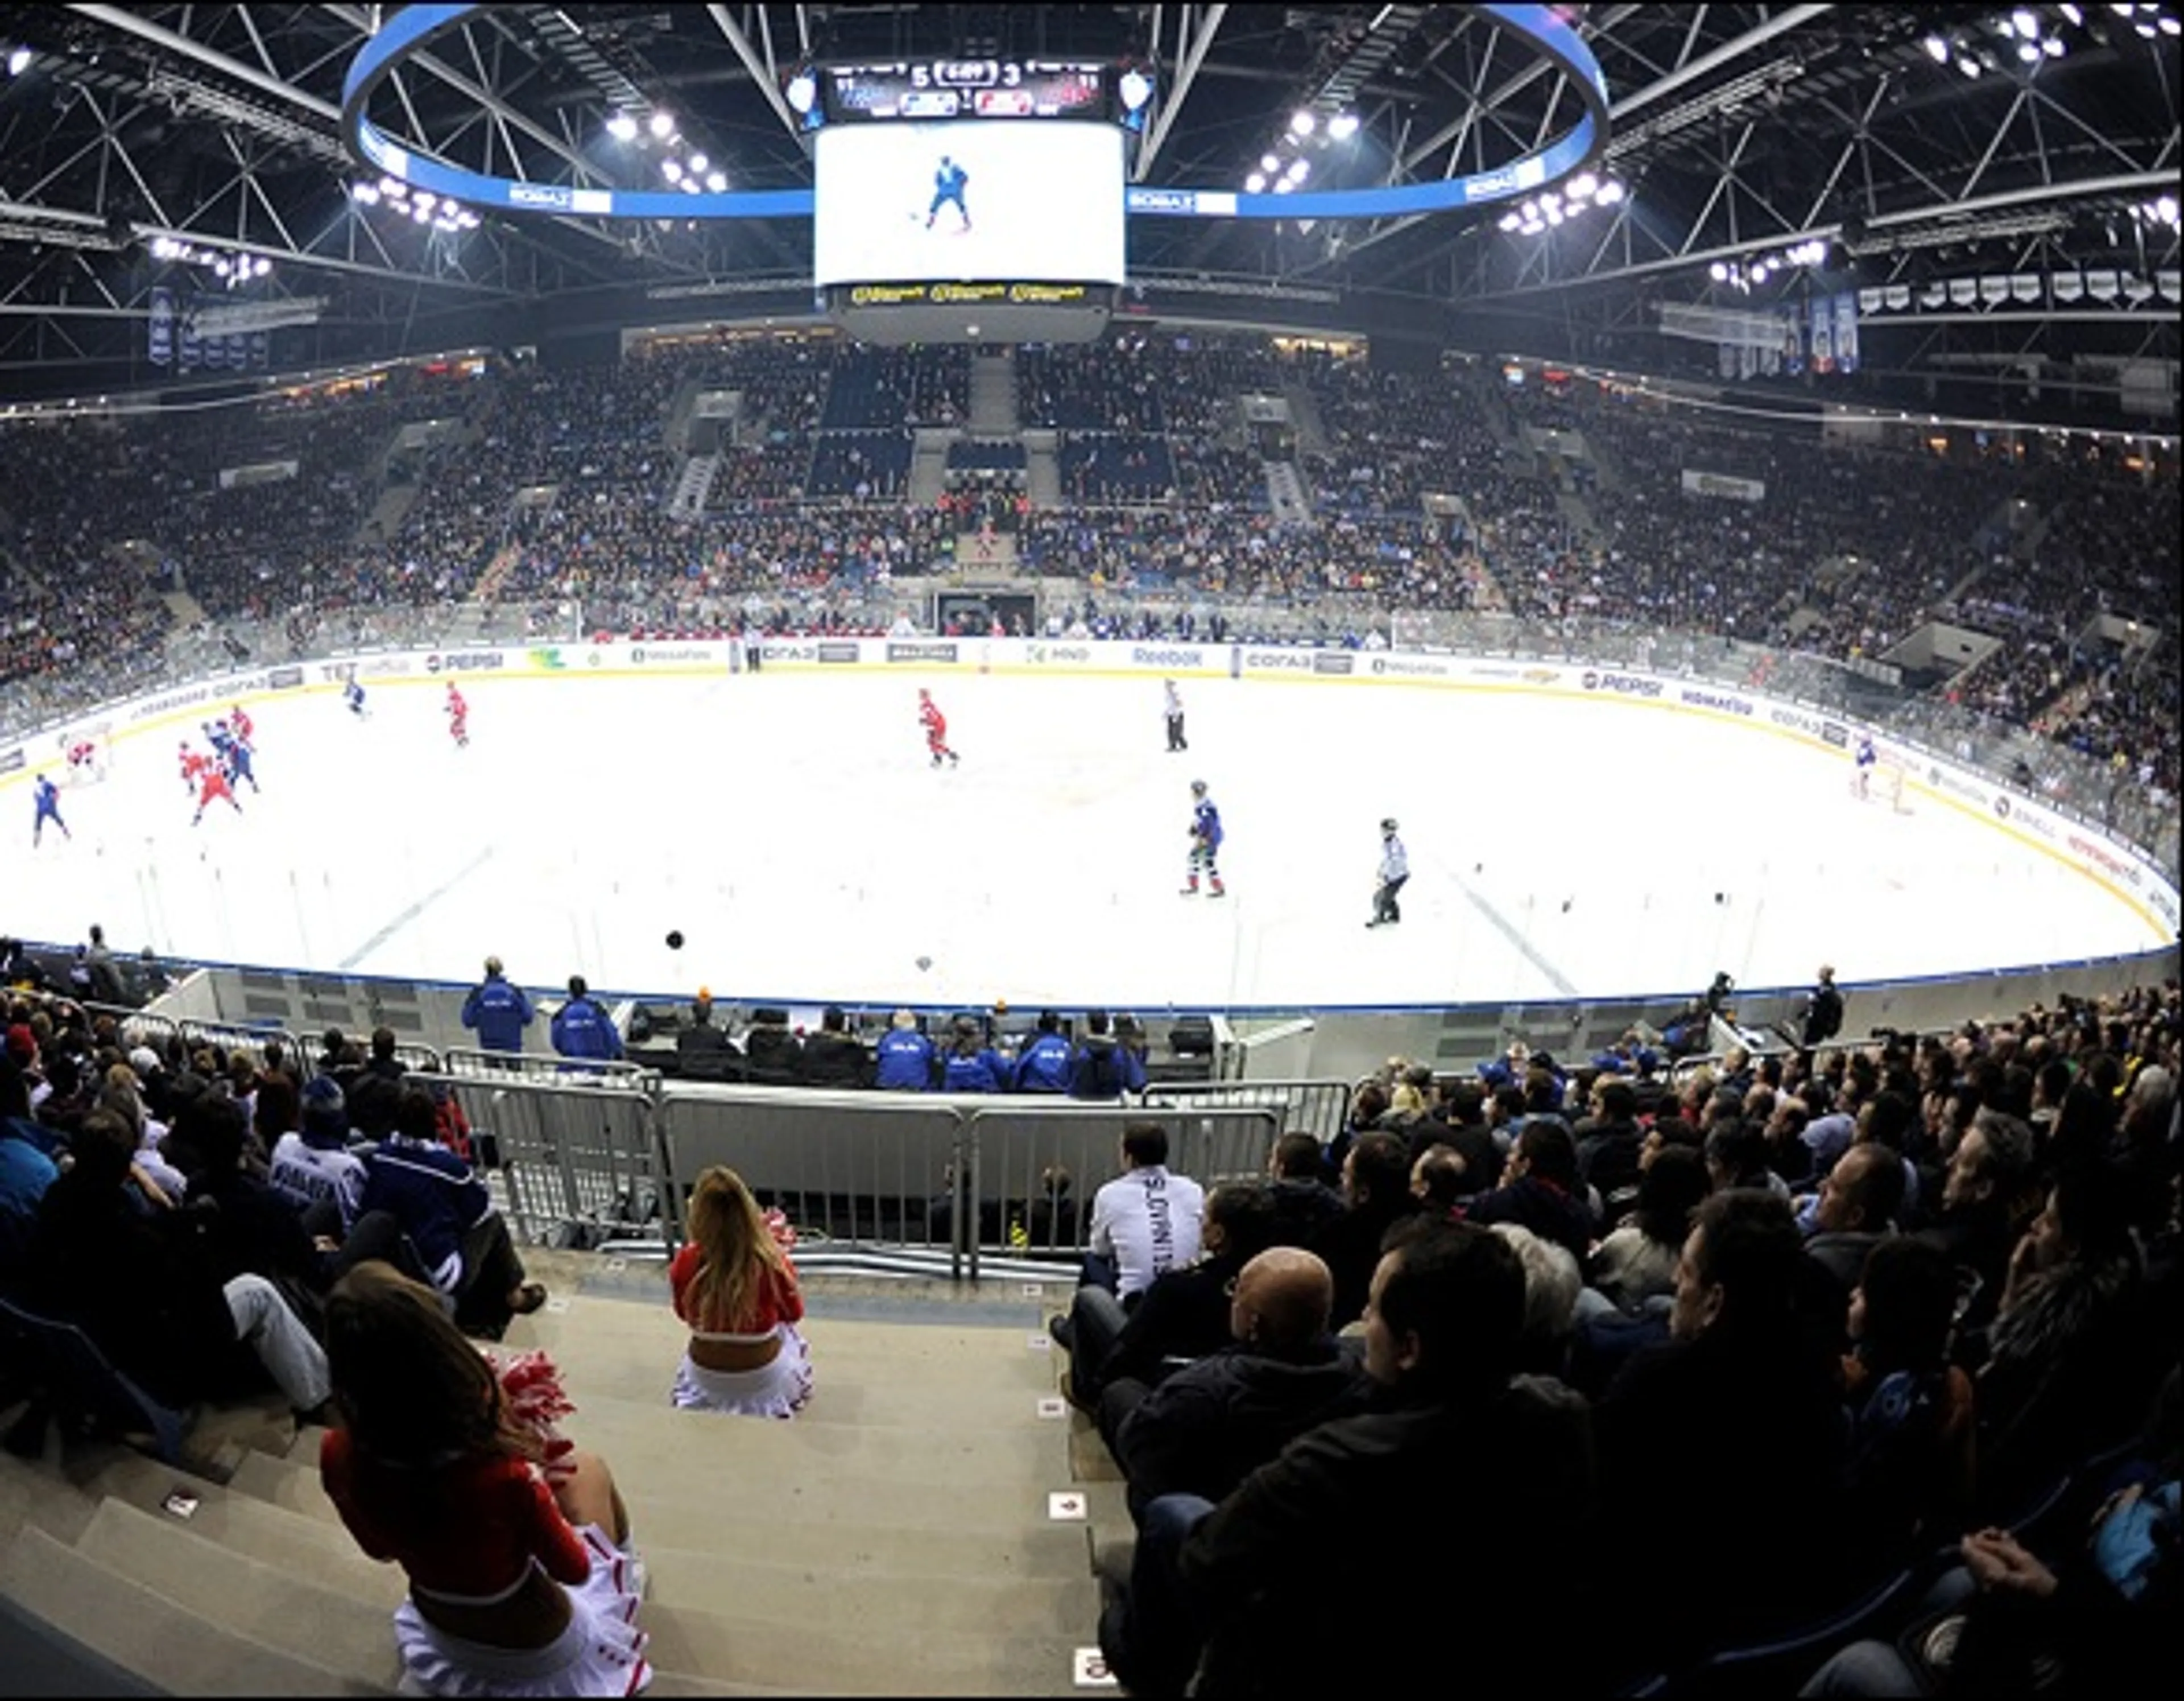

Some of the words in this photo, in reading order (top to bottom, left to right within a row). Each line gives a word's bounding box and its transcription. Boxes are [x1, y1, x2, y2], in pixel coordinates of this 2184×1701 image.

[911, 67, 929, 87] 5
[1004, 63, 1020, 85] 3
[446, 652, 503, 671] PEPSI
[1600, 673, 1664, 697] PEPSI
